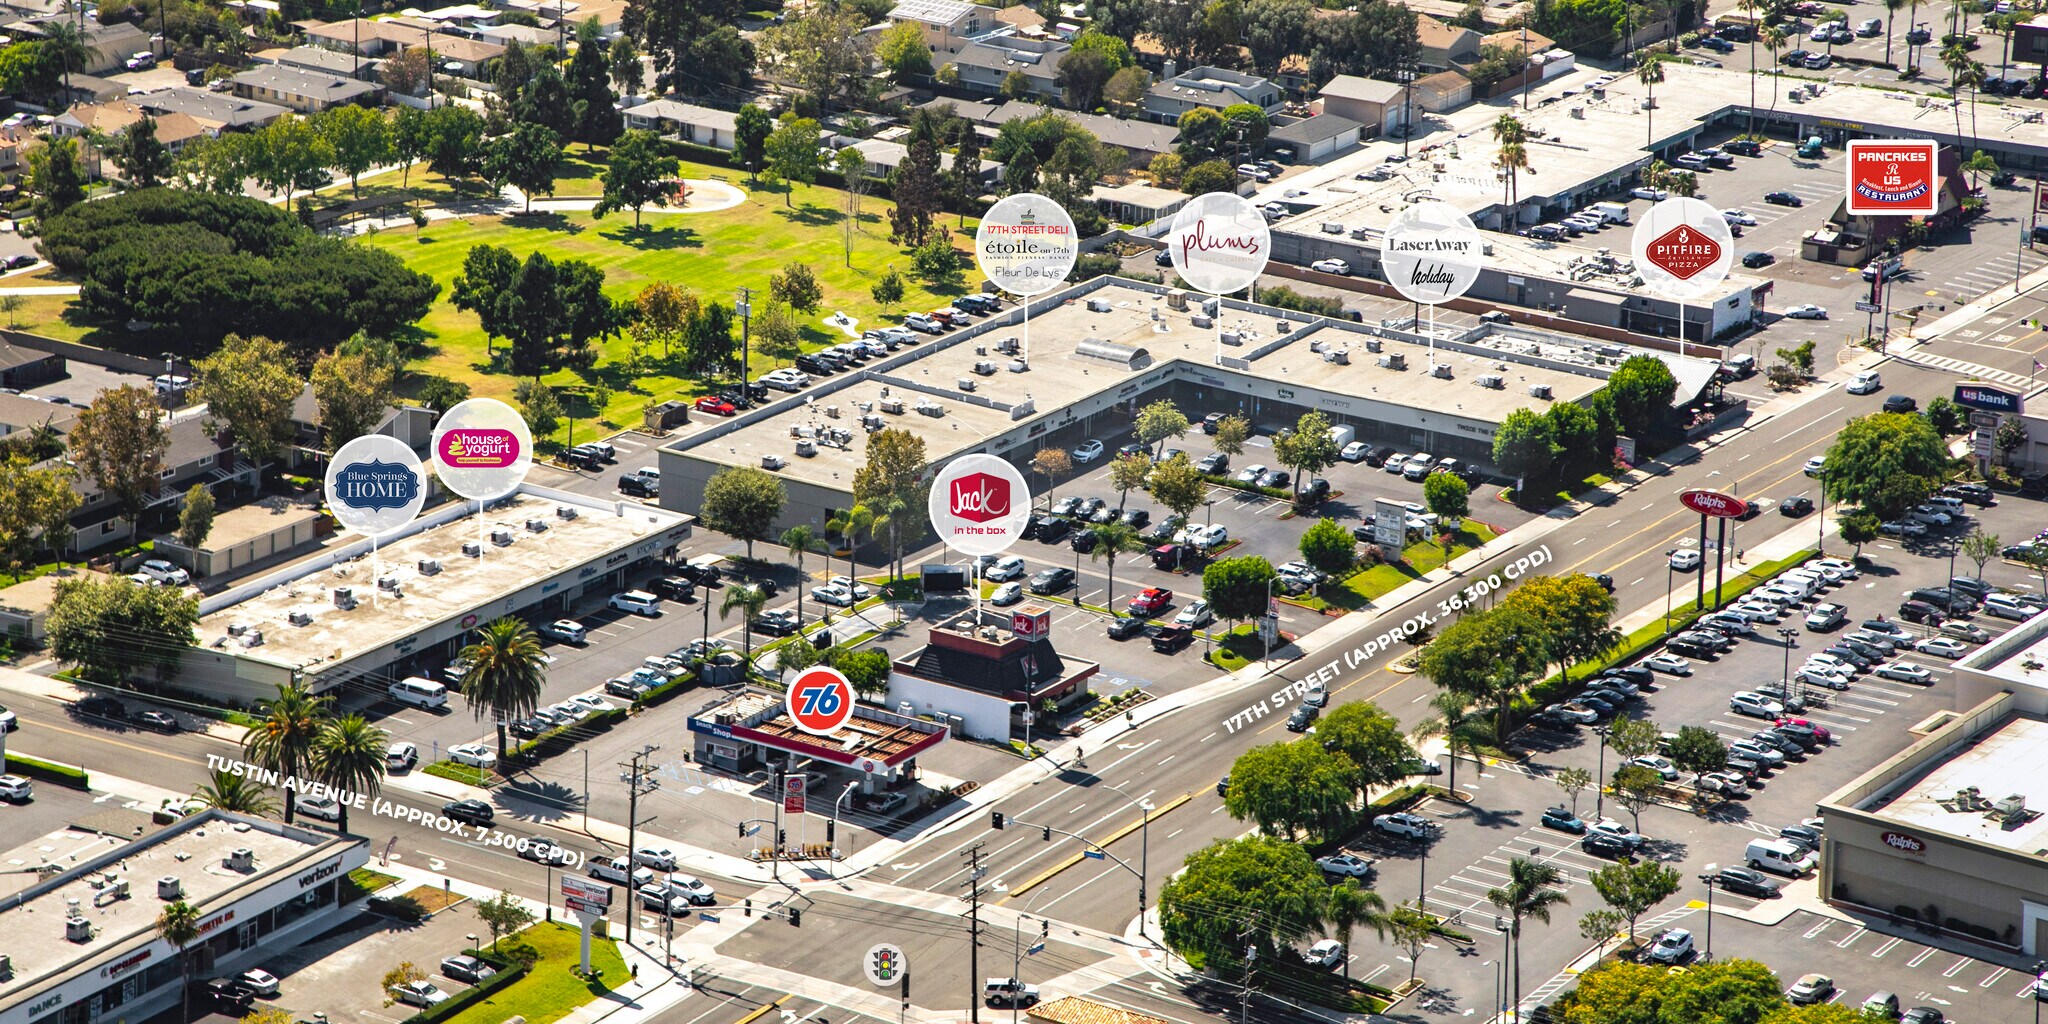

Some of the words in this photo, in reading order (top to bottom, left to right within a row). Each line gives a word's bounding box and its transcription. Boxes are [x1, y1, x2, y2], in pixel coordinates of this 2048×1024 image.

[1457, 424, 1476, 432] TWICE
[1694, 493, 1726, 509] Ralphs
[1014, 617, 1032, 633] Jack
[696, 720, 712, 729] Snack
[713, 728, 731, 738] Shop
[1887, 834, 1920, 850] Ralphs
[299, 862, 340, 888] verizon
[584, 884, 606, 896] verizon
[28, 994, 62, 1017] DANCE
